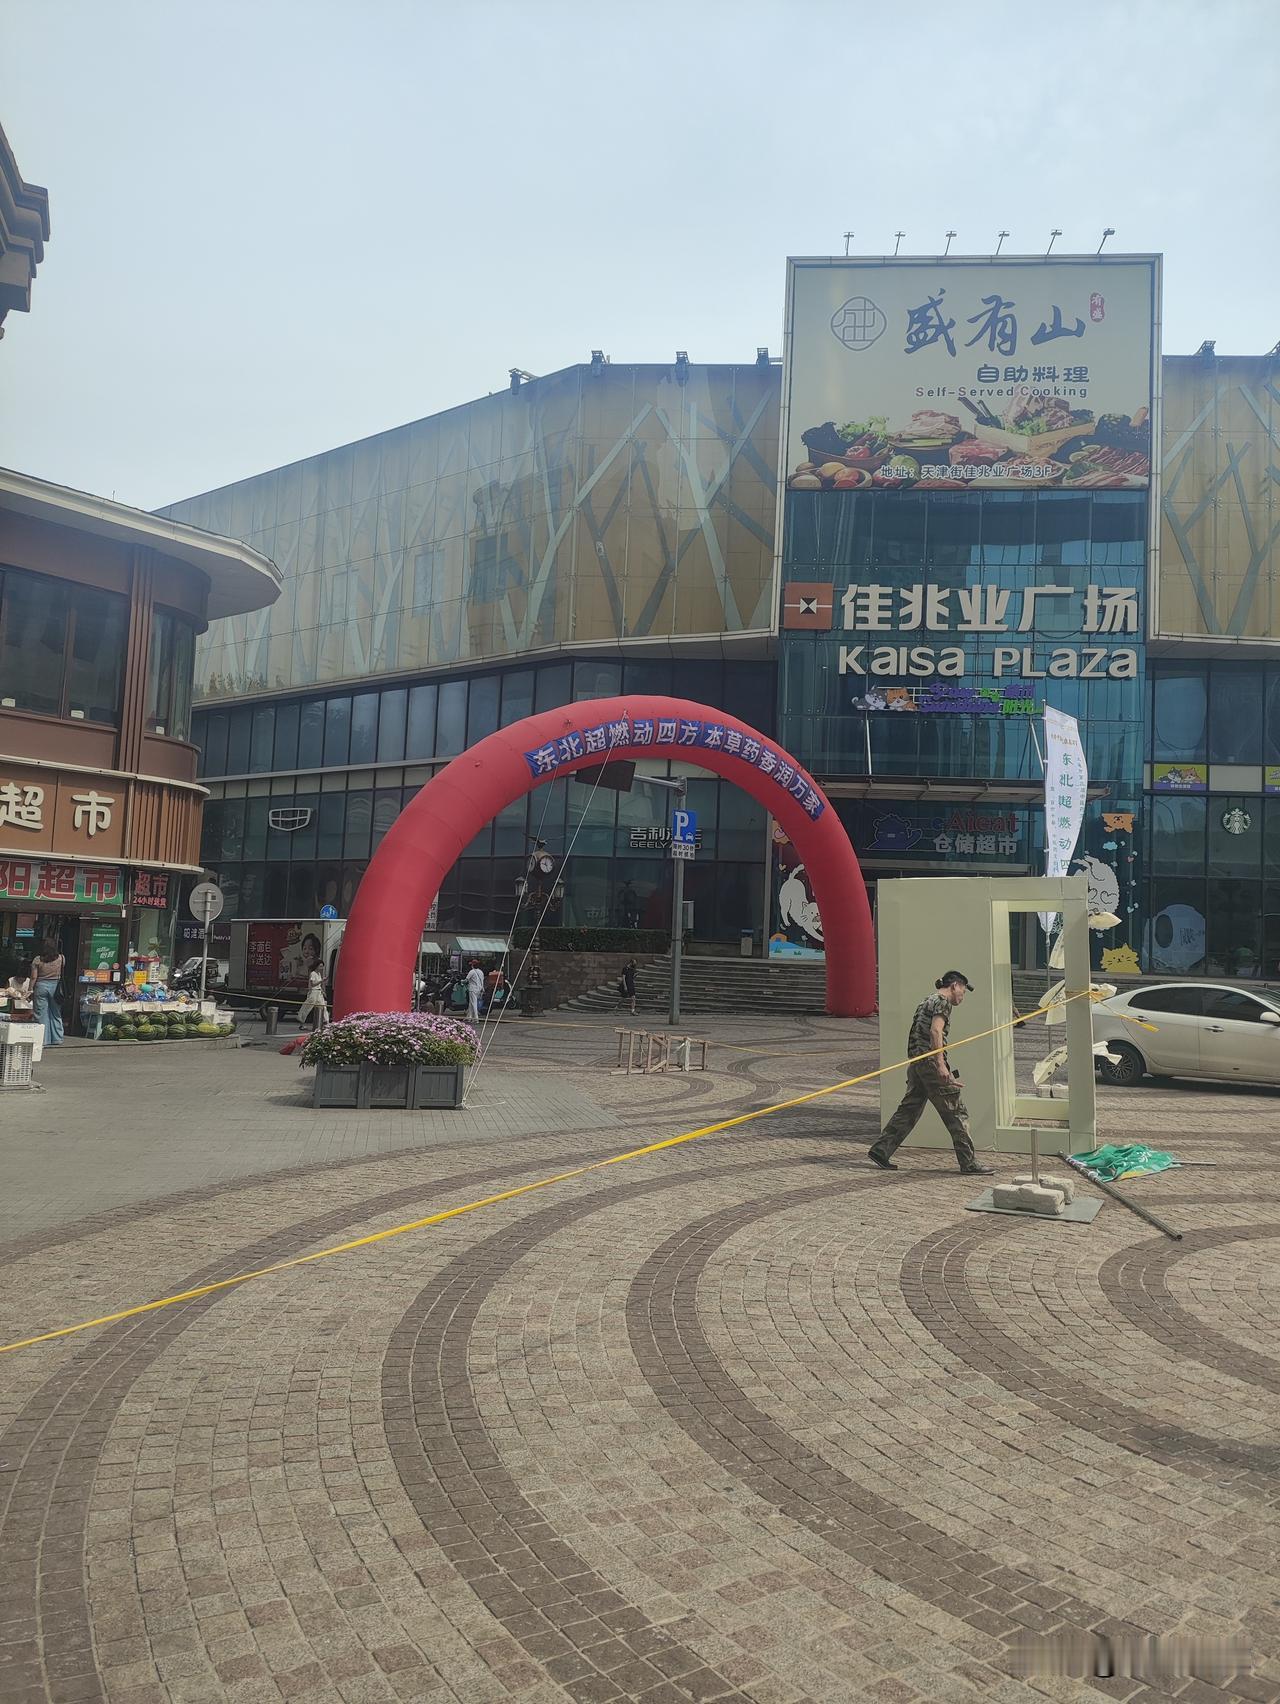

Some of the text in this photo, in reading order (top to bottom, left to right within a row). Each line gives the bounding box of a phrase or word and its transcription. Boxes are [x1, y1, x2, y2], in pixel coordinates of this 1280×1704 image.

[976, 363, 1090, 384] 自助料理
[915, 386, 1088, 399] Self-Served Cooking
[841, 583, 1138, 633] 佳兆业广场
[533, 720, 699, 775] 东北超燃动四方
[0, 781, 116, 836] 超市
[674, 811, 689, 841] P
[630, 841, 667, 849] GEELY
[933, 833, 1018, 856] 仓储超市
